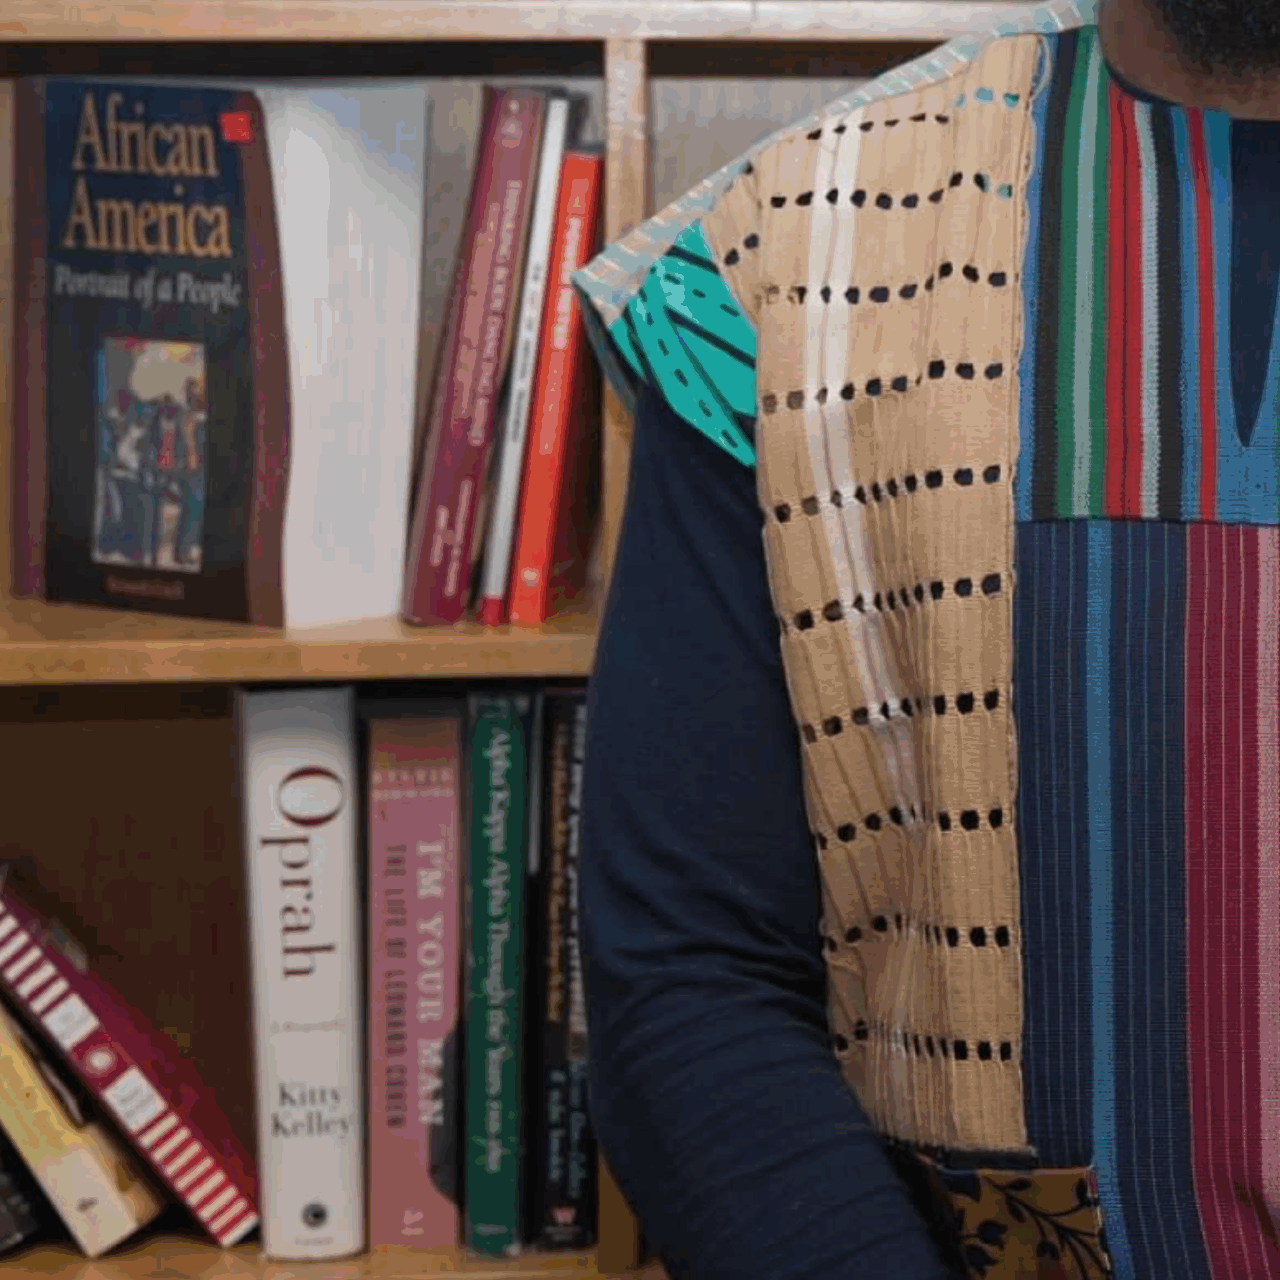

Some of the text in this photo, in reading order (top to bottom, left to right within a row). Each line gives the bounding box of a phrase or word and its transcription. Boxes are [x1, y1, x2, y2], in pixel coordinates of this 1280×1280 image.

[73, 89, 219, 177] African
[63, 174, 233, 258] America
[55, 264, 242, 314] Portrait of a People
[258, 765, 344, 980] Oprah
[418, 841, 444, 1126] I'M YOUR MAN
[270, 1110, 350, 1142] Kelley
[278, 1082, 341, 1111] Kitty
